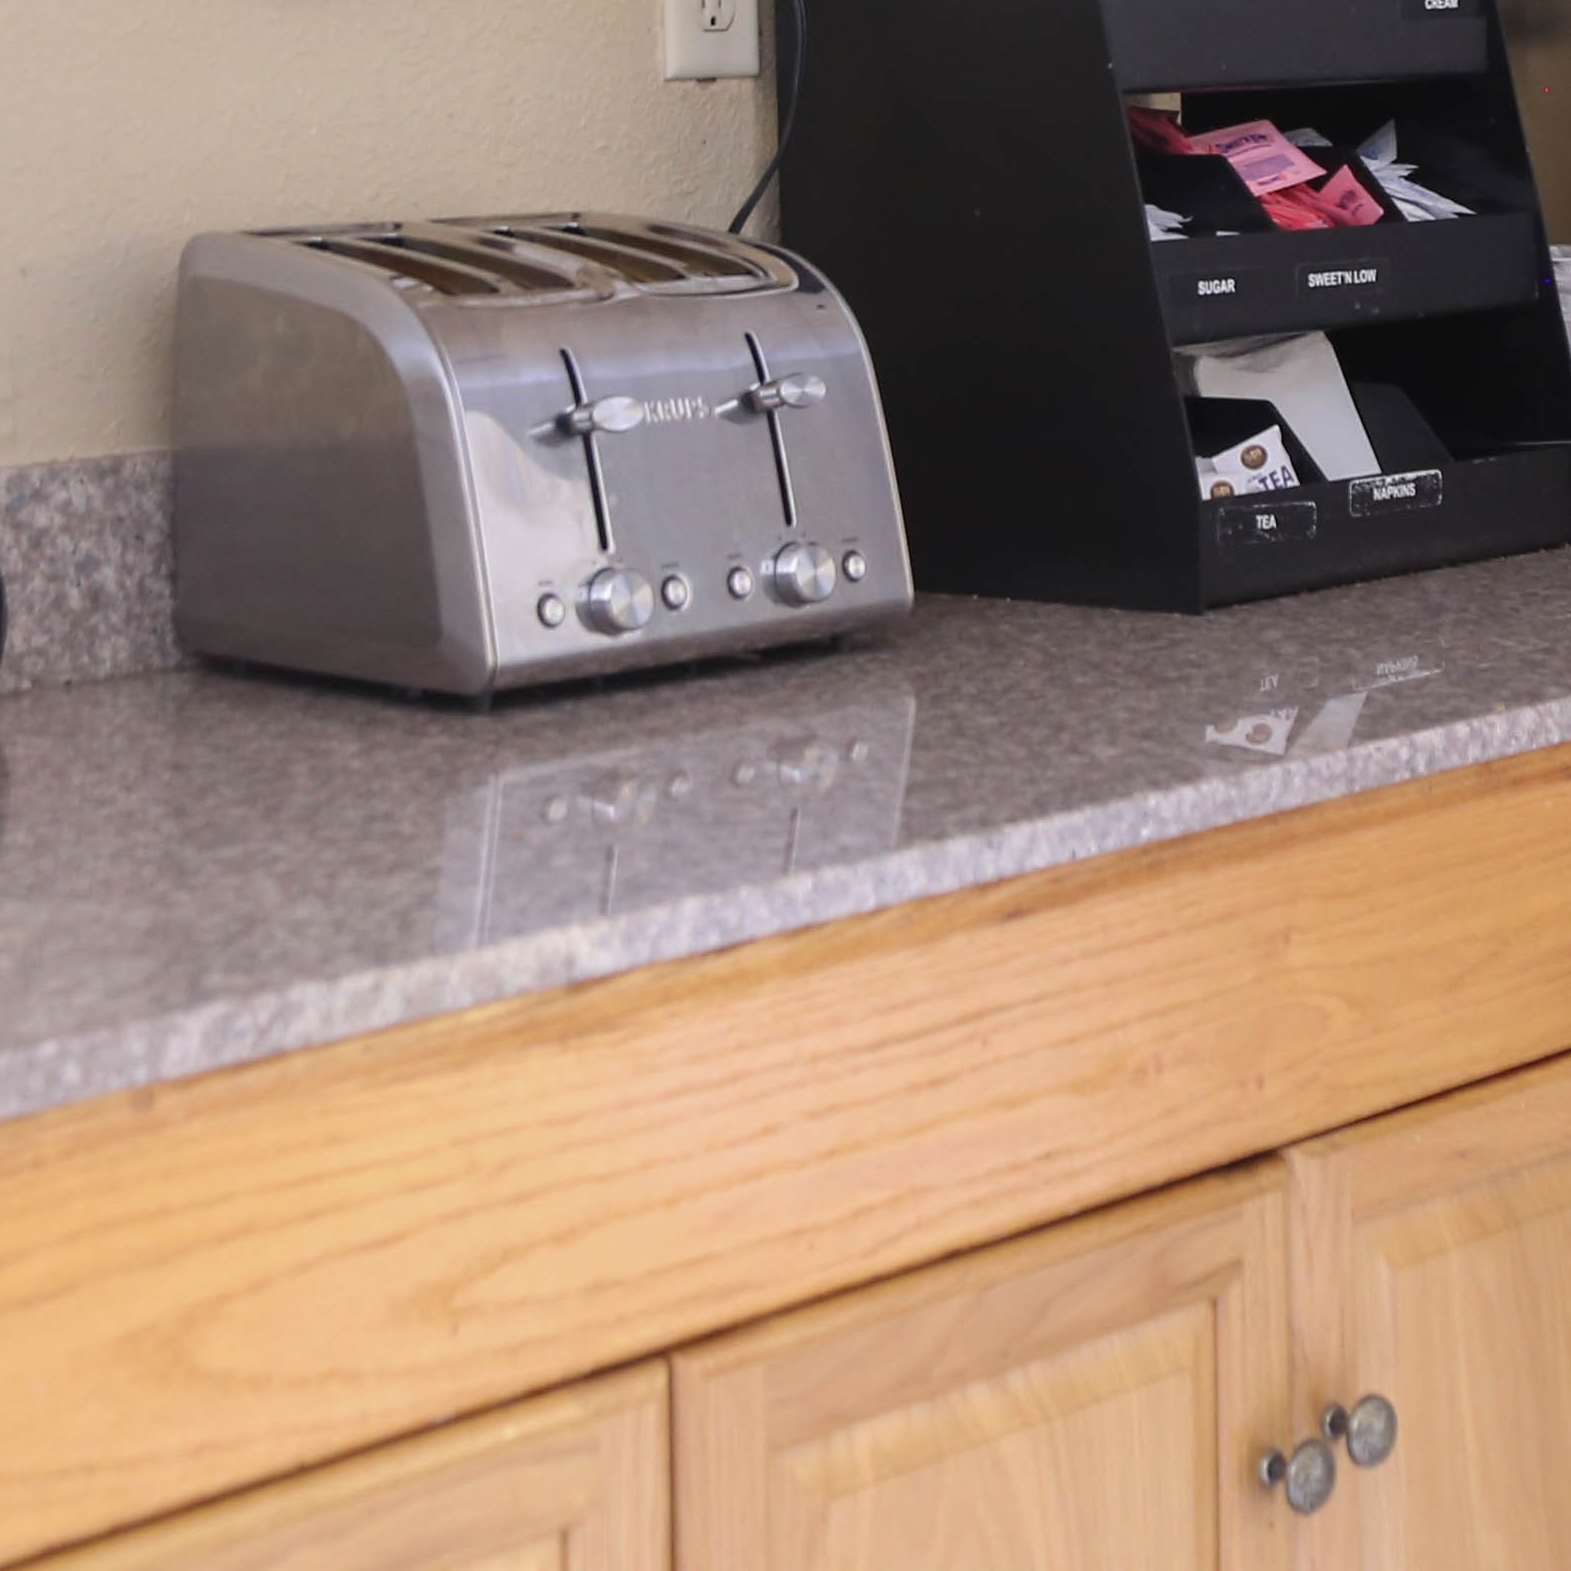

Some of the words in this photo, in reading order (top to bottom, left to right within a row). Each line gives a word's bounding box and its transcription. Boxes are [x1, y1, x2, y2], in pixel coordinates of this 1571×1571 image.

[1354, 269, 1377, 284] LOW
[1198, 278, 1236, 295] SUGAR
[1258, 465, 1295, 491] TEA
[1373, 482, 1417, 501] NAPKINS
[1255, 513, 1277, 530] TEA
